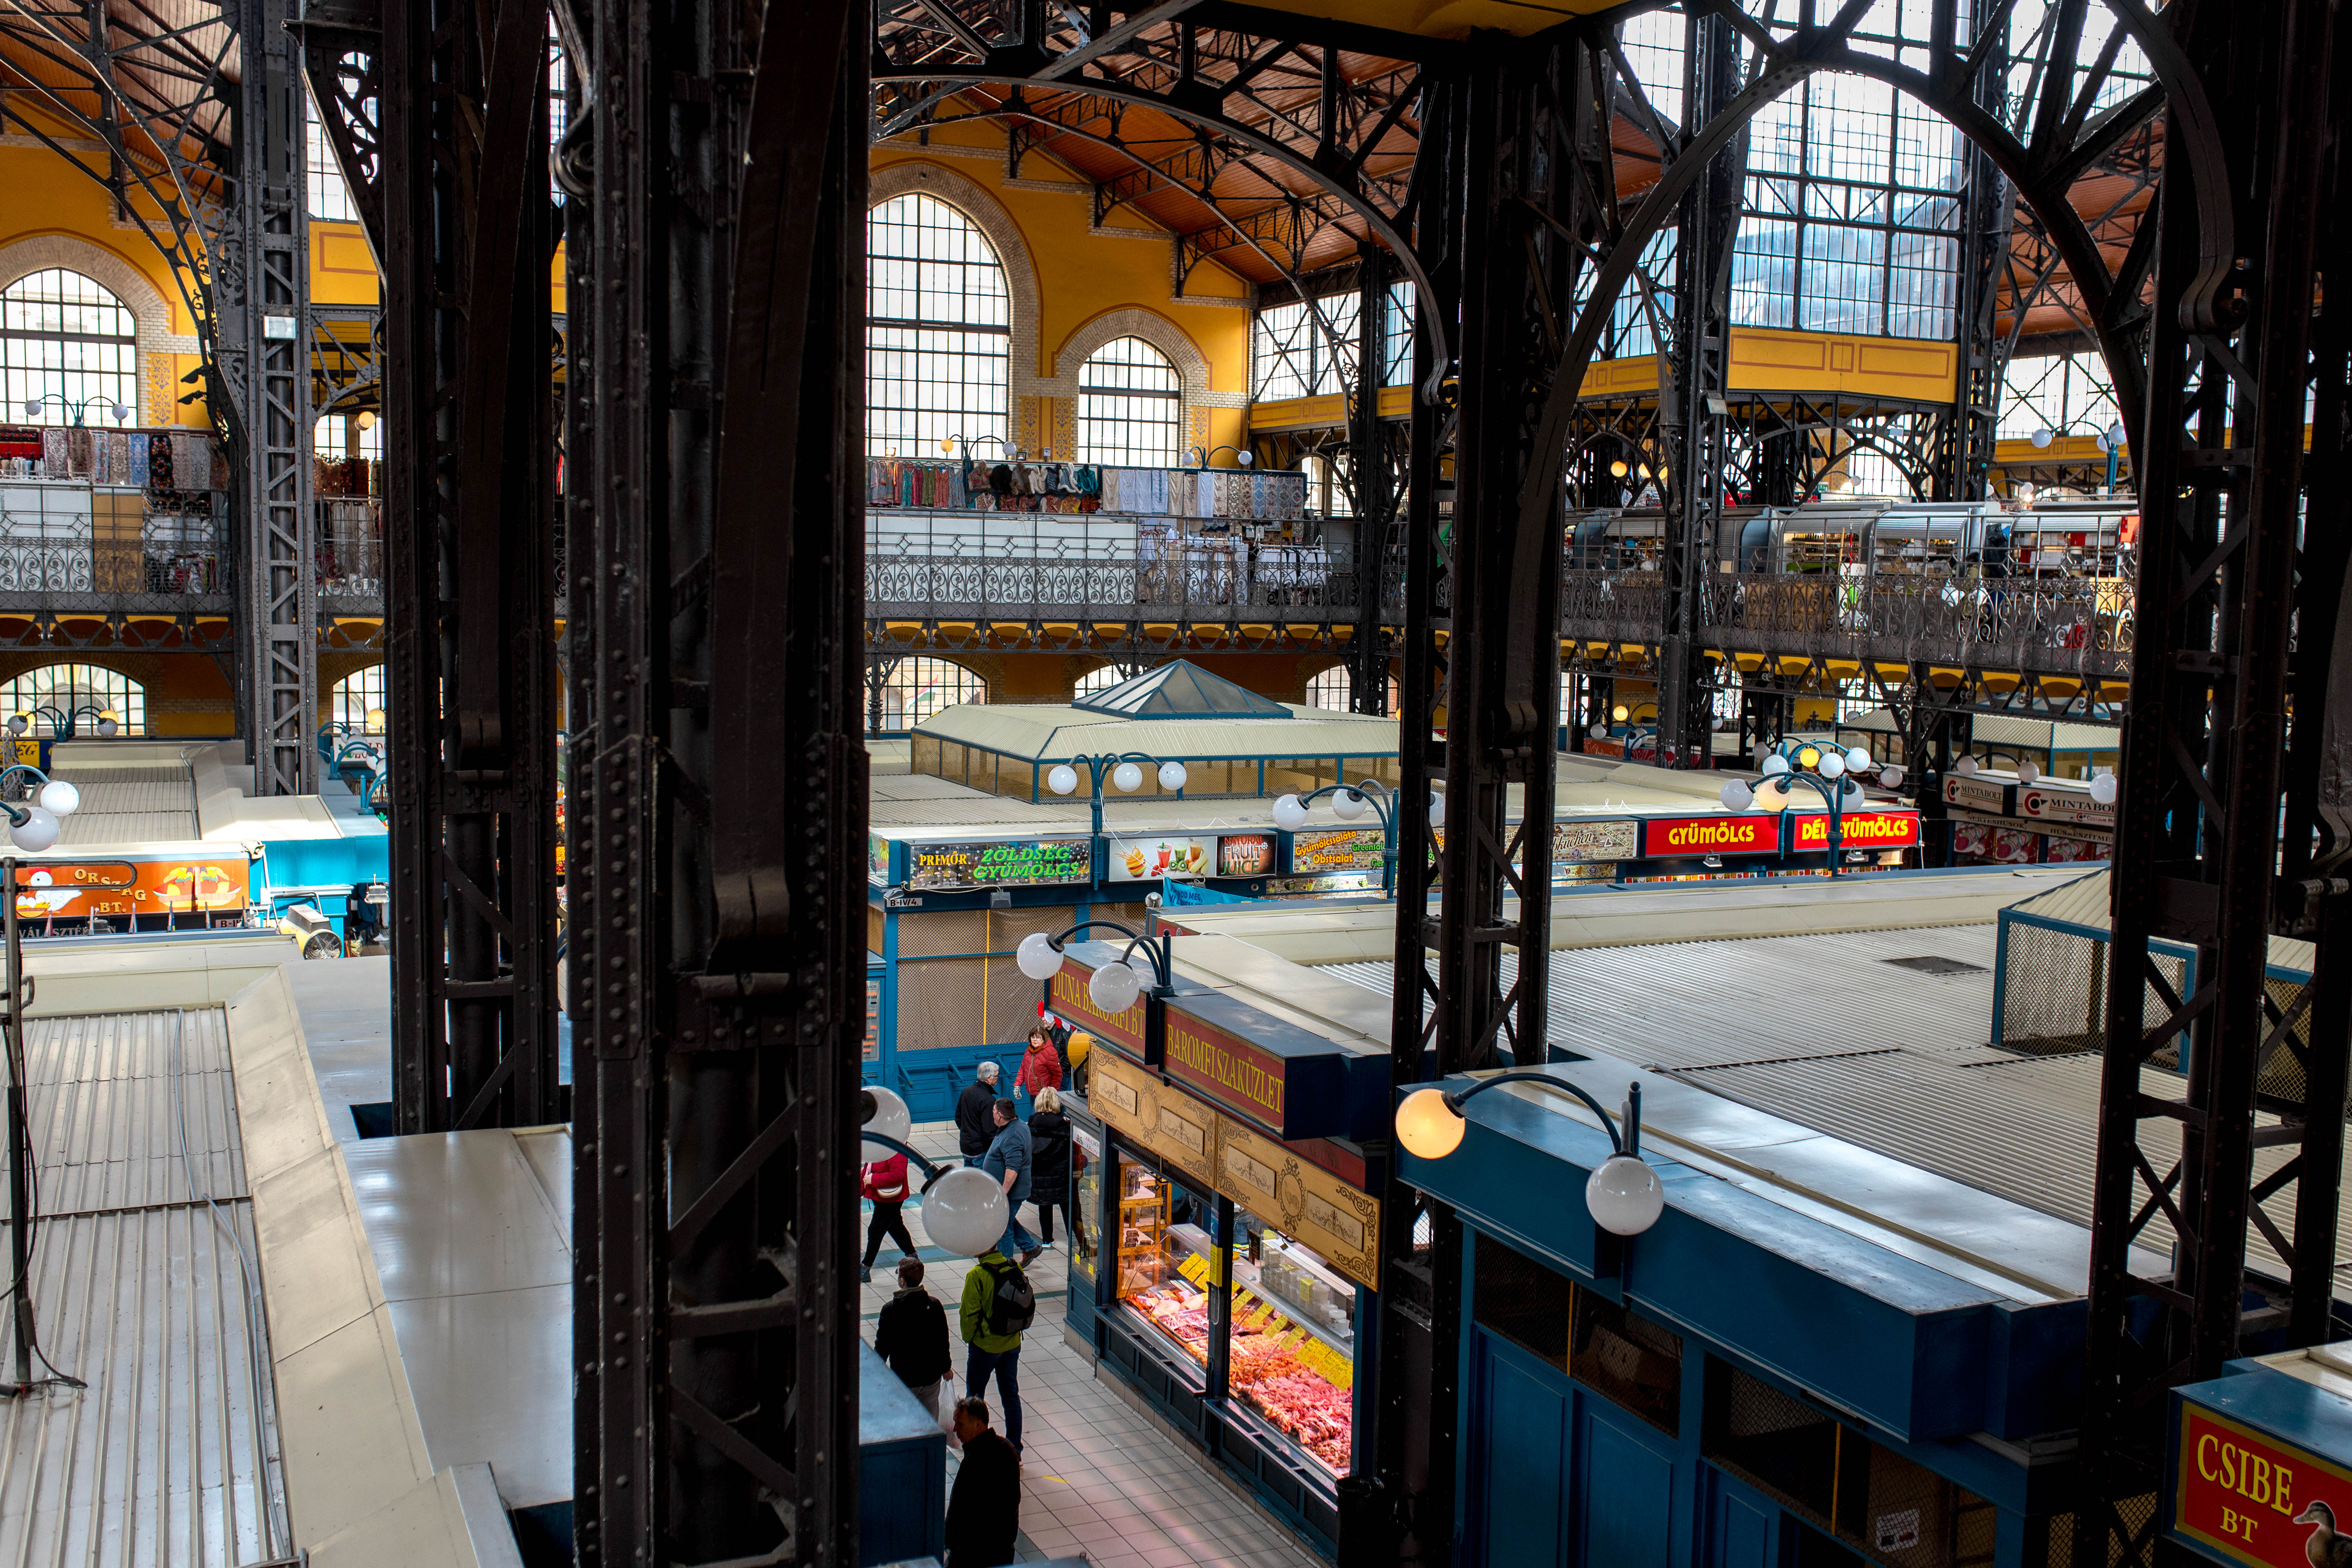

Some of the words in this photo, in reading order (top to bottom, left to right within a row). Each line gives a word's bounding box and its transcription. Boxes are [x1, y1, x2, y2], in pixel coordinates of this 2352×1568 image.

[1961, 785, 2002, 800] MINTABOLT
[1669, 822, 1755, 845] GYÜMÖLCS
[1802, 816, 1908, 840] DÉLYÜMÖLCS
[1224, 845, 1263, 859] FRUIT
[1295, 830, 1358, 856] Gyümölcssaláta
[920, 851, 967, 866] PRIMŐR
[981, 844, 1071, 863] ZÖLDSÉG
[1312, 853, 1354, 864] Obstsalat
[973, 861, 1080, 879] GYÜMÖLCS
[1221, 860, 1259, 875] JUICE
[1189, 892, 1202, 903] MEG,
[99, 902, 126, 913] BT.
[1054, 971, 1081, 1009] DUNA
[1131, 1005, 1145, 1040] BT
[1167, 1023, 1216, 1079] BAROMFI
[1217, 1049, 1284, 1114] SZAKÜZLET
[2197, 1434, 2294, 1516] CSIBE
[2220, 1506, 2258, 1543] BT
